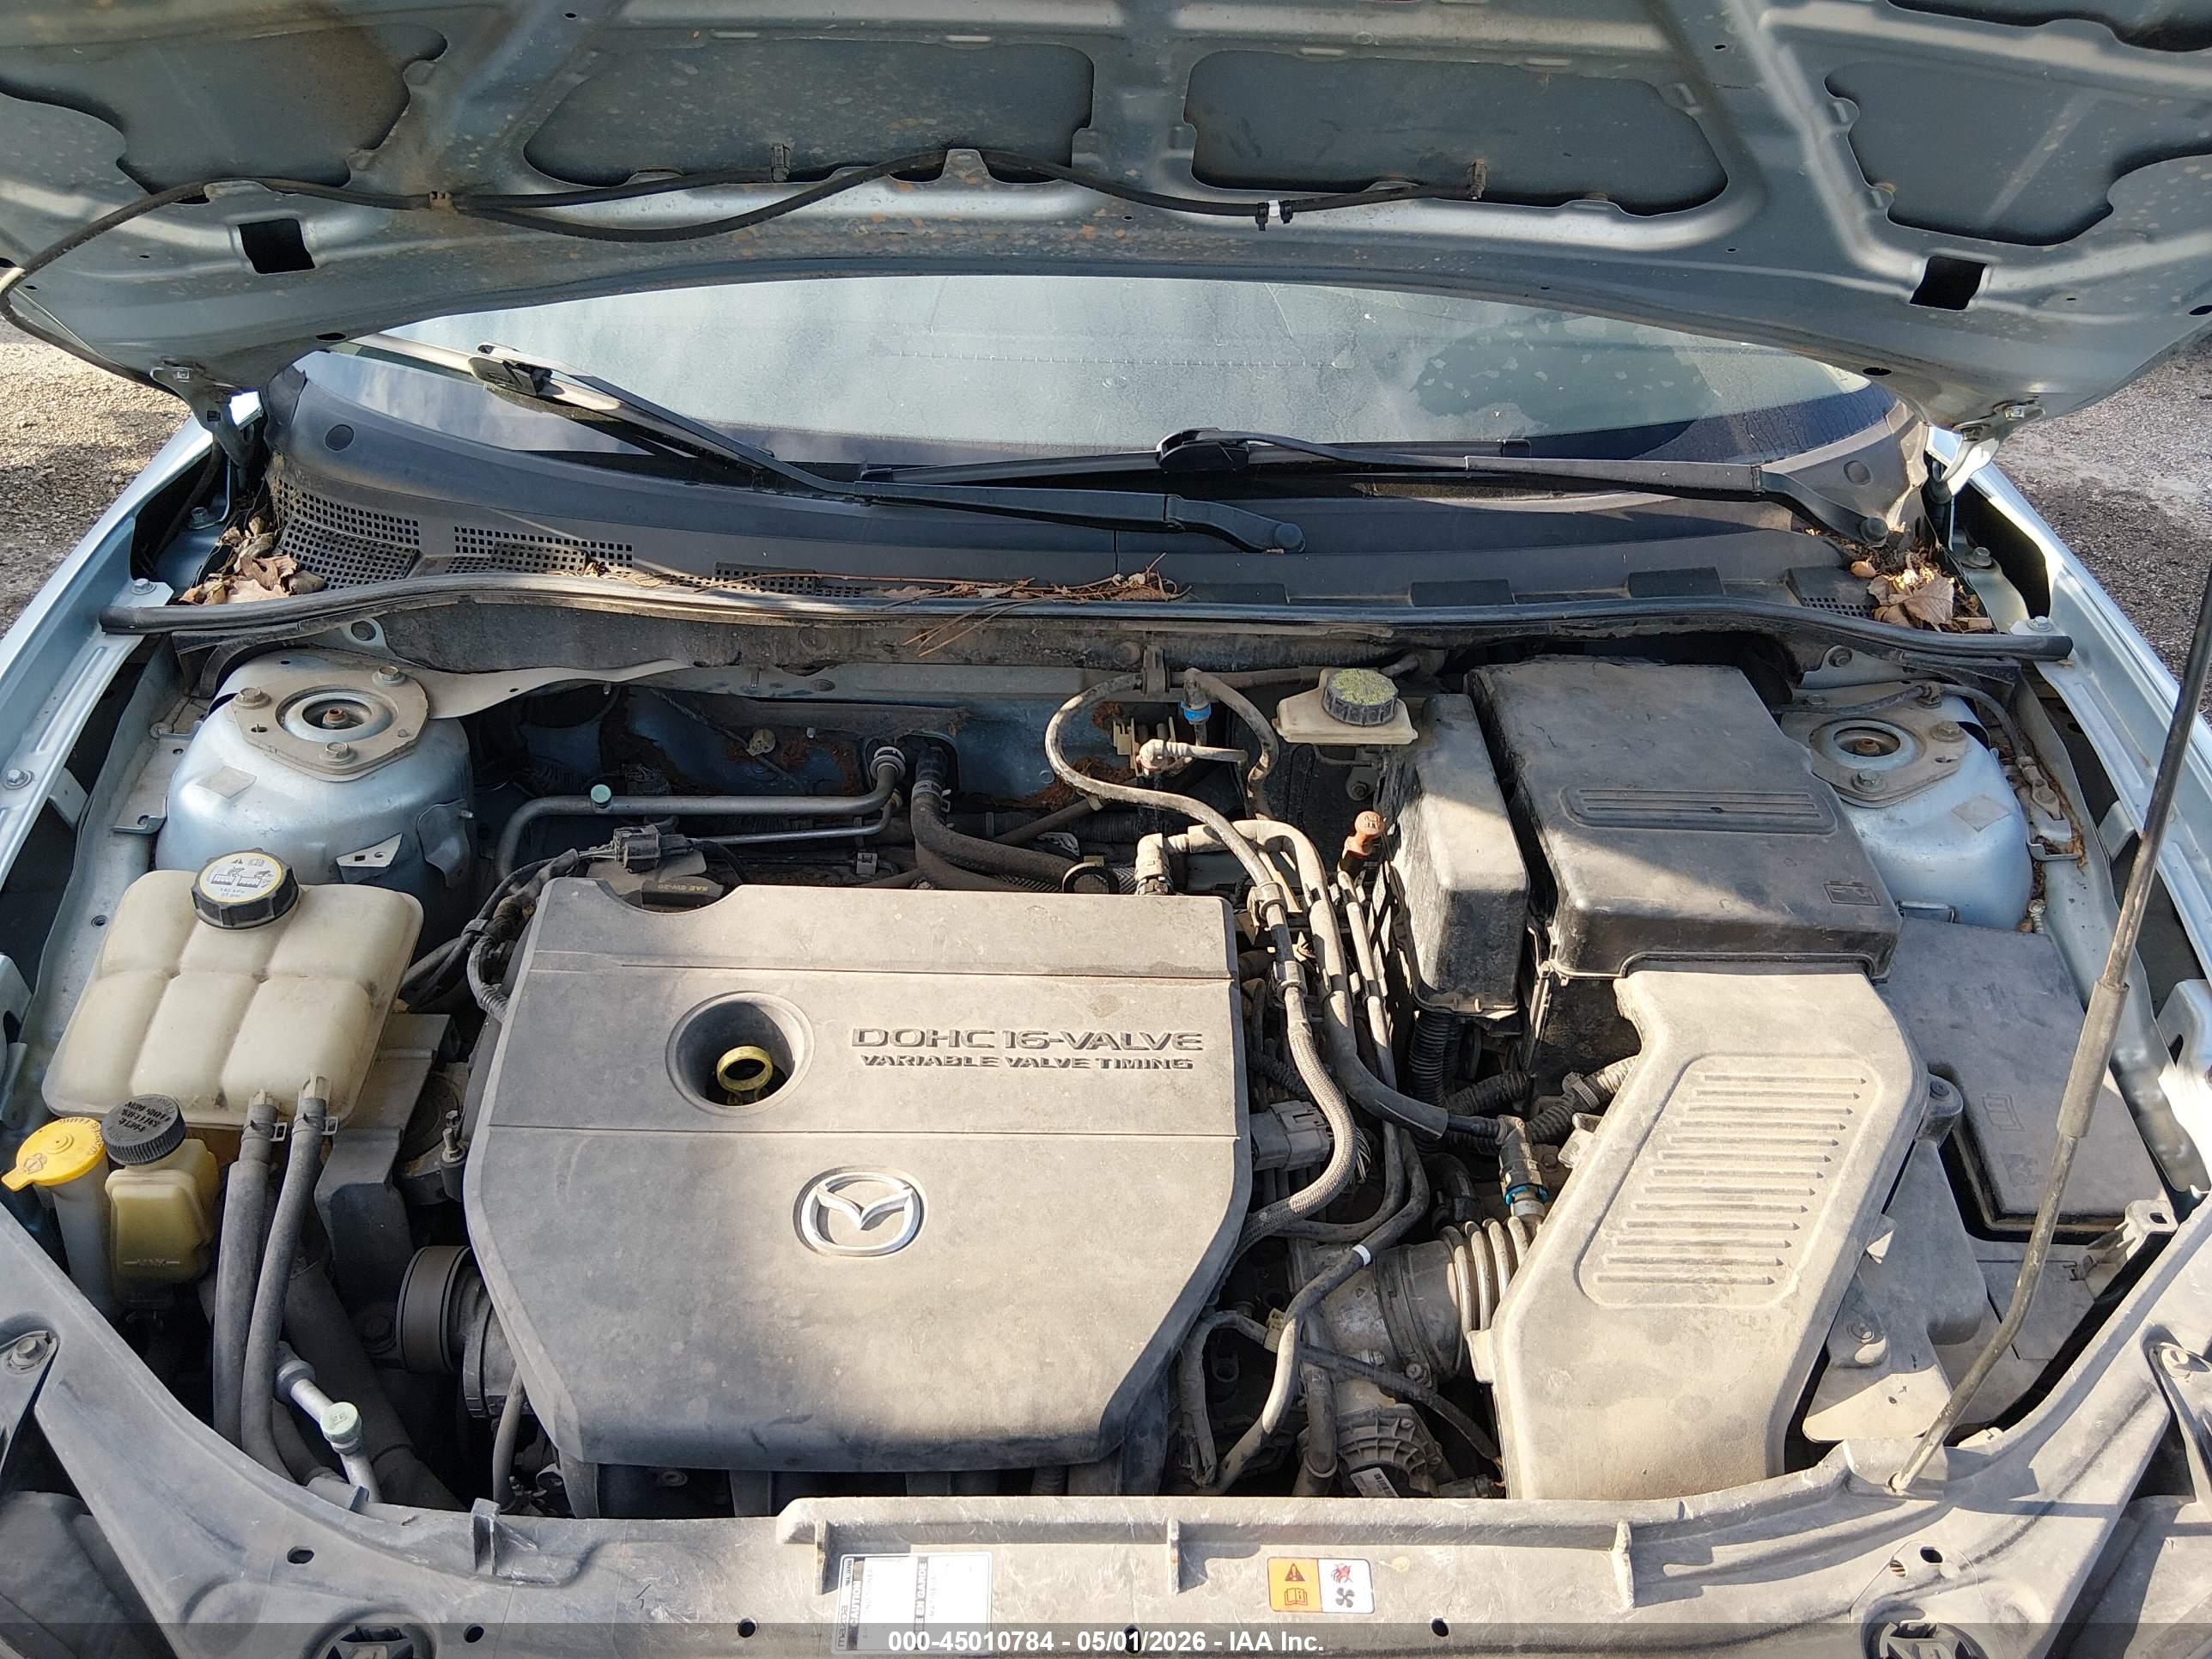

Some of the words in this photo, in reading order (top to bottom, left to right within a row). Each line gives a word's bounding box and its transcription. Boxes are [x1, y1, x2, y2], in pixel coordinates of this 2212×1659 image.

[851, 1028, 995, 1049] DOHC
[1003, 1029, 1205, 1052] 16-VALVE
[860, 1054, 1000, 1069] VARIABLE
[1005, 1055, 1093, 1070] VALVE
[1095, 1056, 1195, 1071] TIMING
[916, 1561, 928, 1599] GARDE
[849, 1580, 862, 1628] CAUTION
